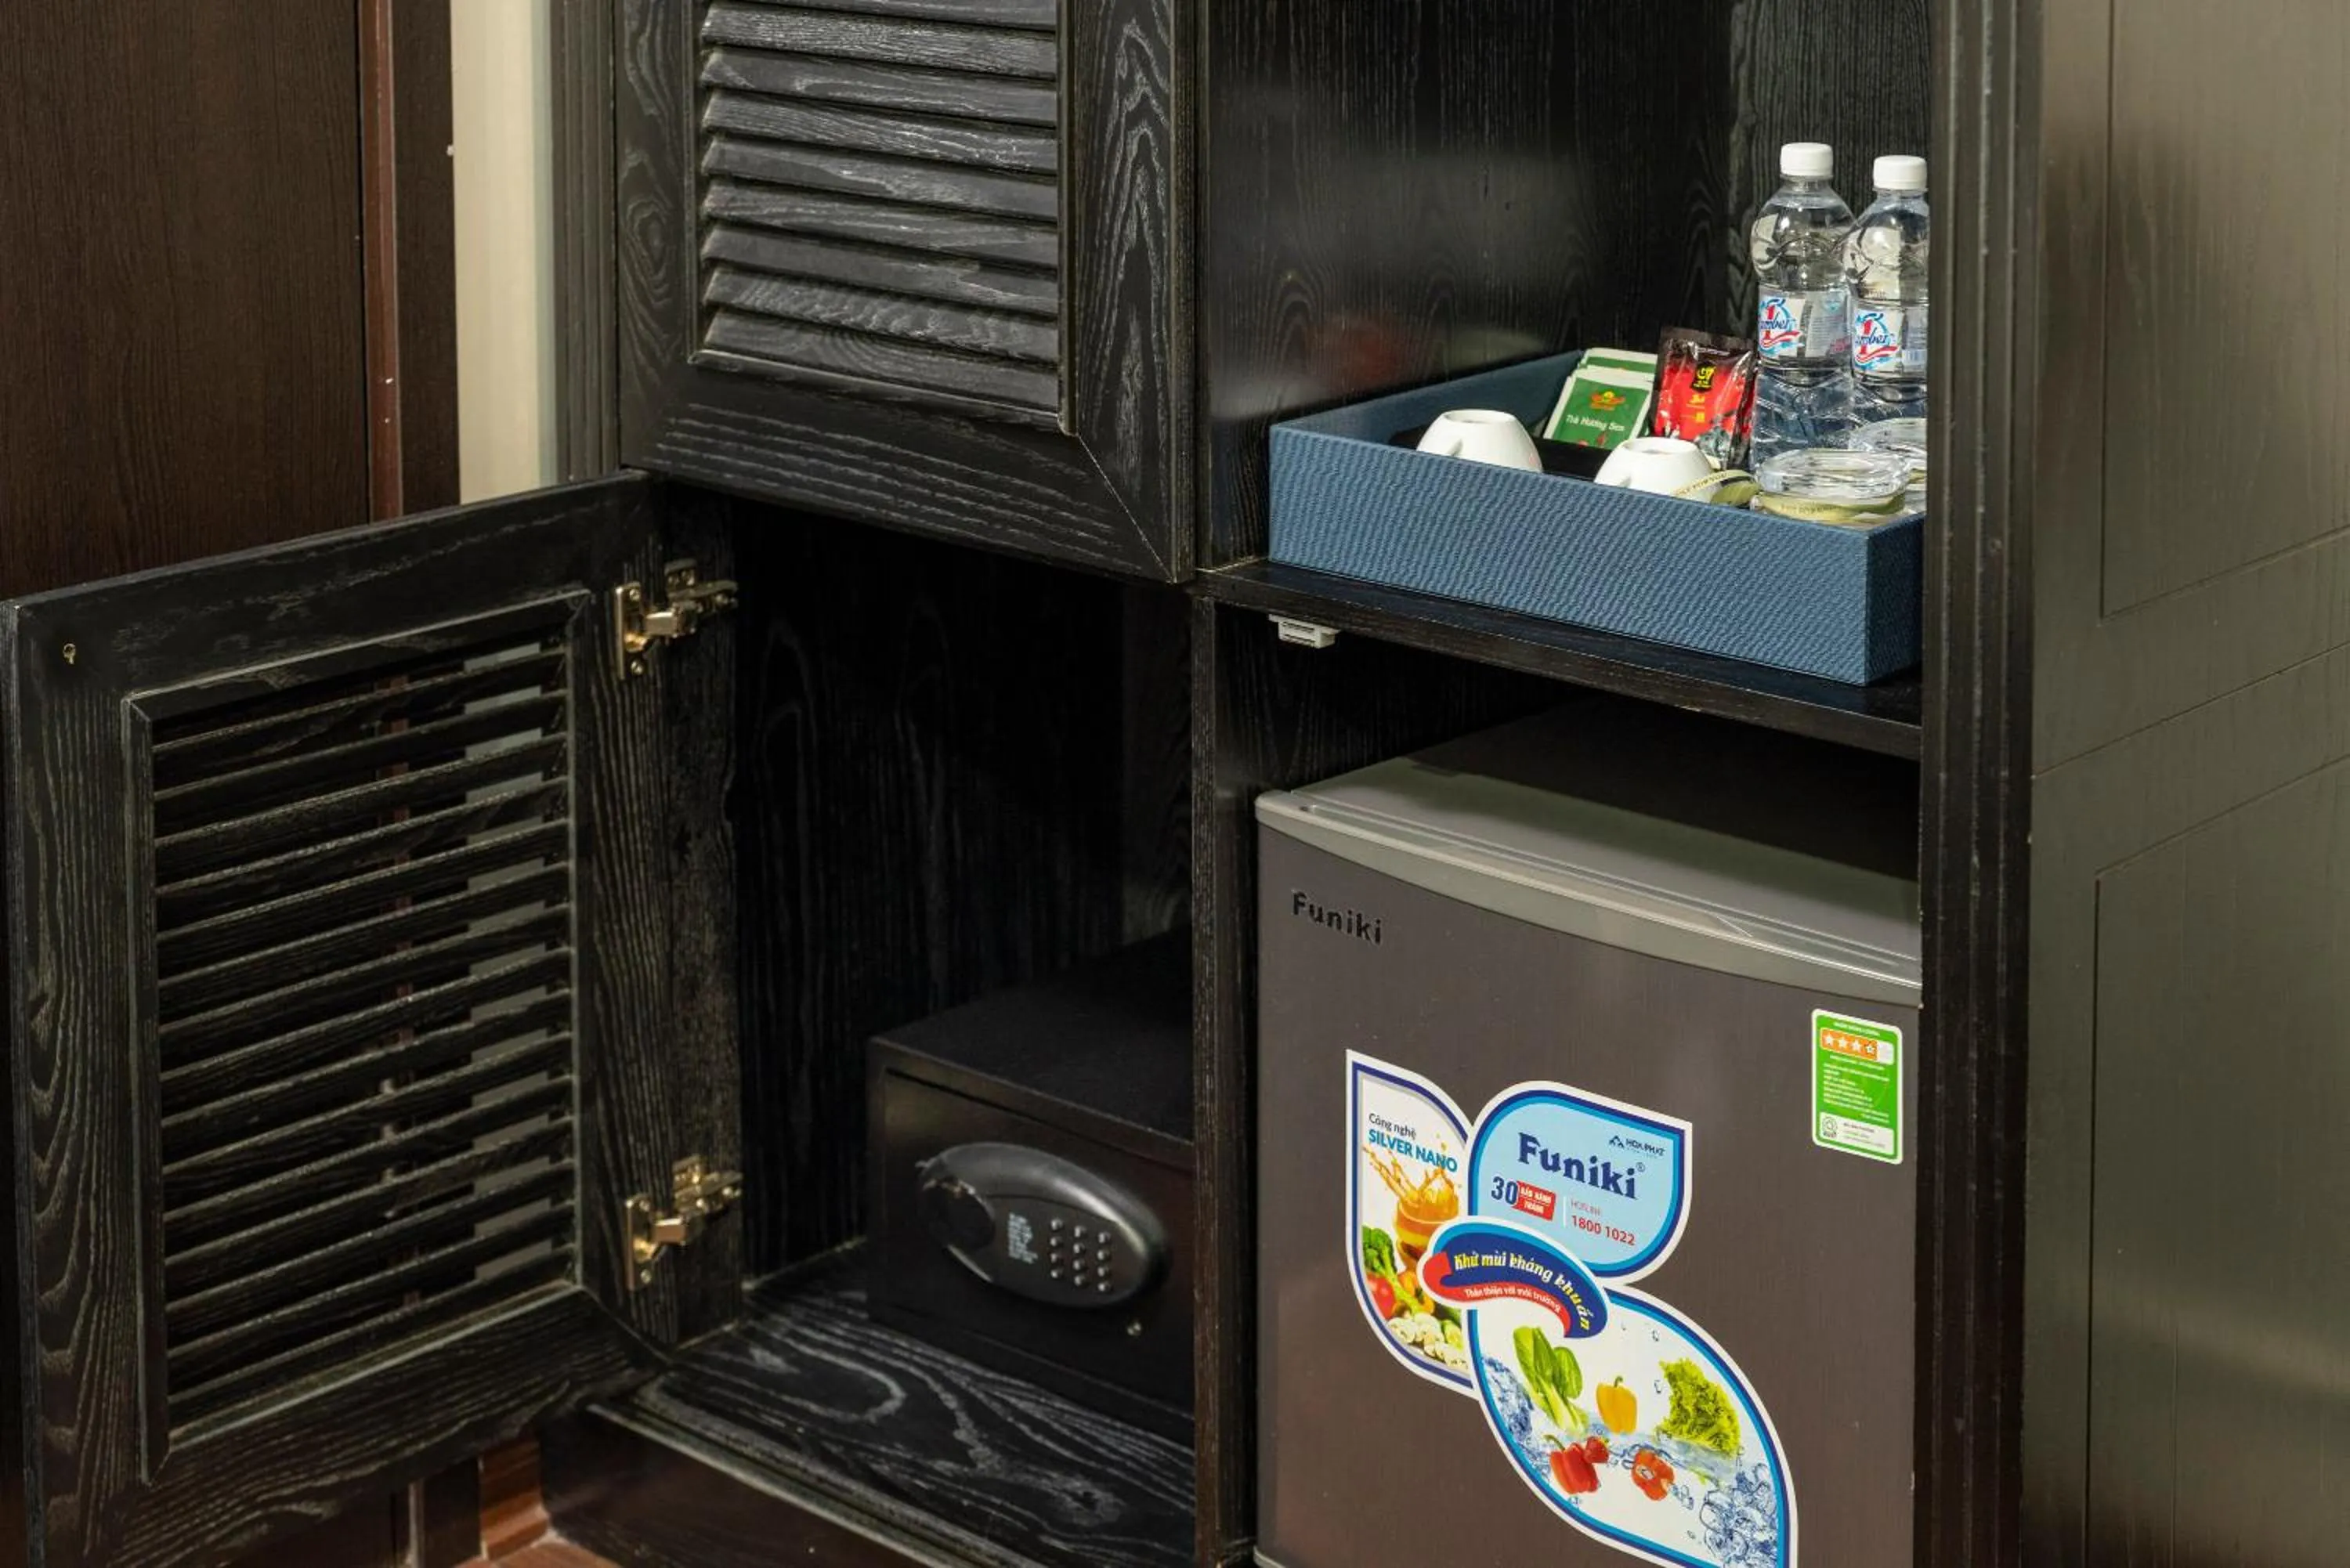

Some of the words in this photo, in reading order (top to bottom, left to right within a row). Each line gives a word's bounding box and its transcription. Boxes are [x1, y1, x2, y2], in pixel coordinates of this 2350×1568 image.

[1292, 891, 1381, 943] Funiki
[1368, 1113, 1392, 1132] Công
[1394, 1124, 1416, 1140] nghệ
[1368, 1129, 1413, 1158] SILVER
[1415, 1145, 1458, 1172] NANO
[1518, 1133, 1638, 1200] Funiki
[1491, 1176, 1518, 1205] 30
[1571, 1215, 1601, 1234] 1800
[1605, 1226, 1635, 1245] 1022
[1455, 1251, 1479, 1270] Khử
[1481, 1250, 1506, 1266] mùi
[1509, 1253, 1553, 1284] kháng
